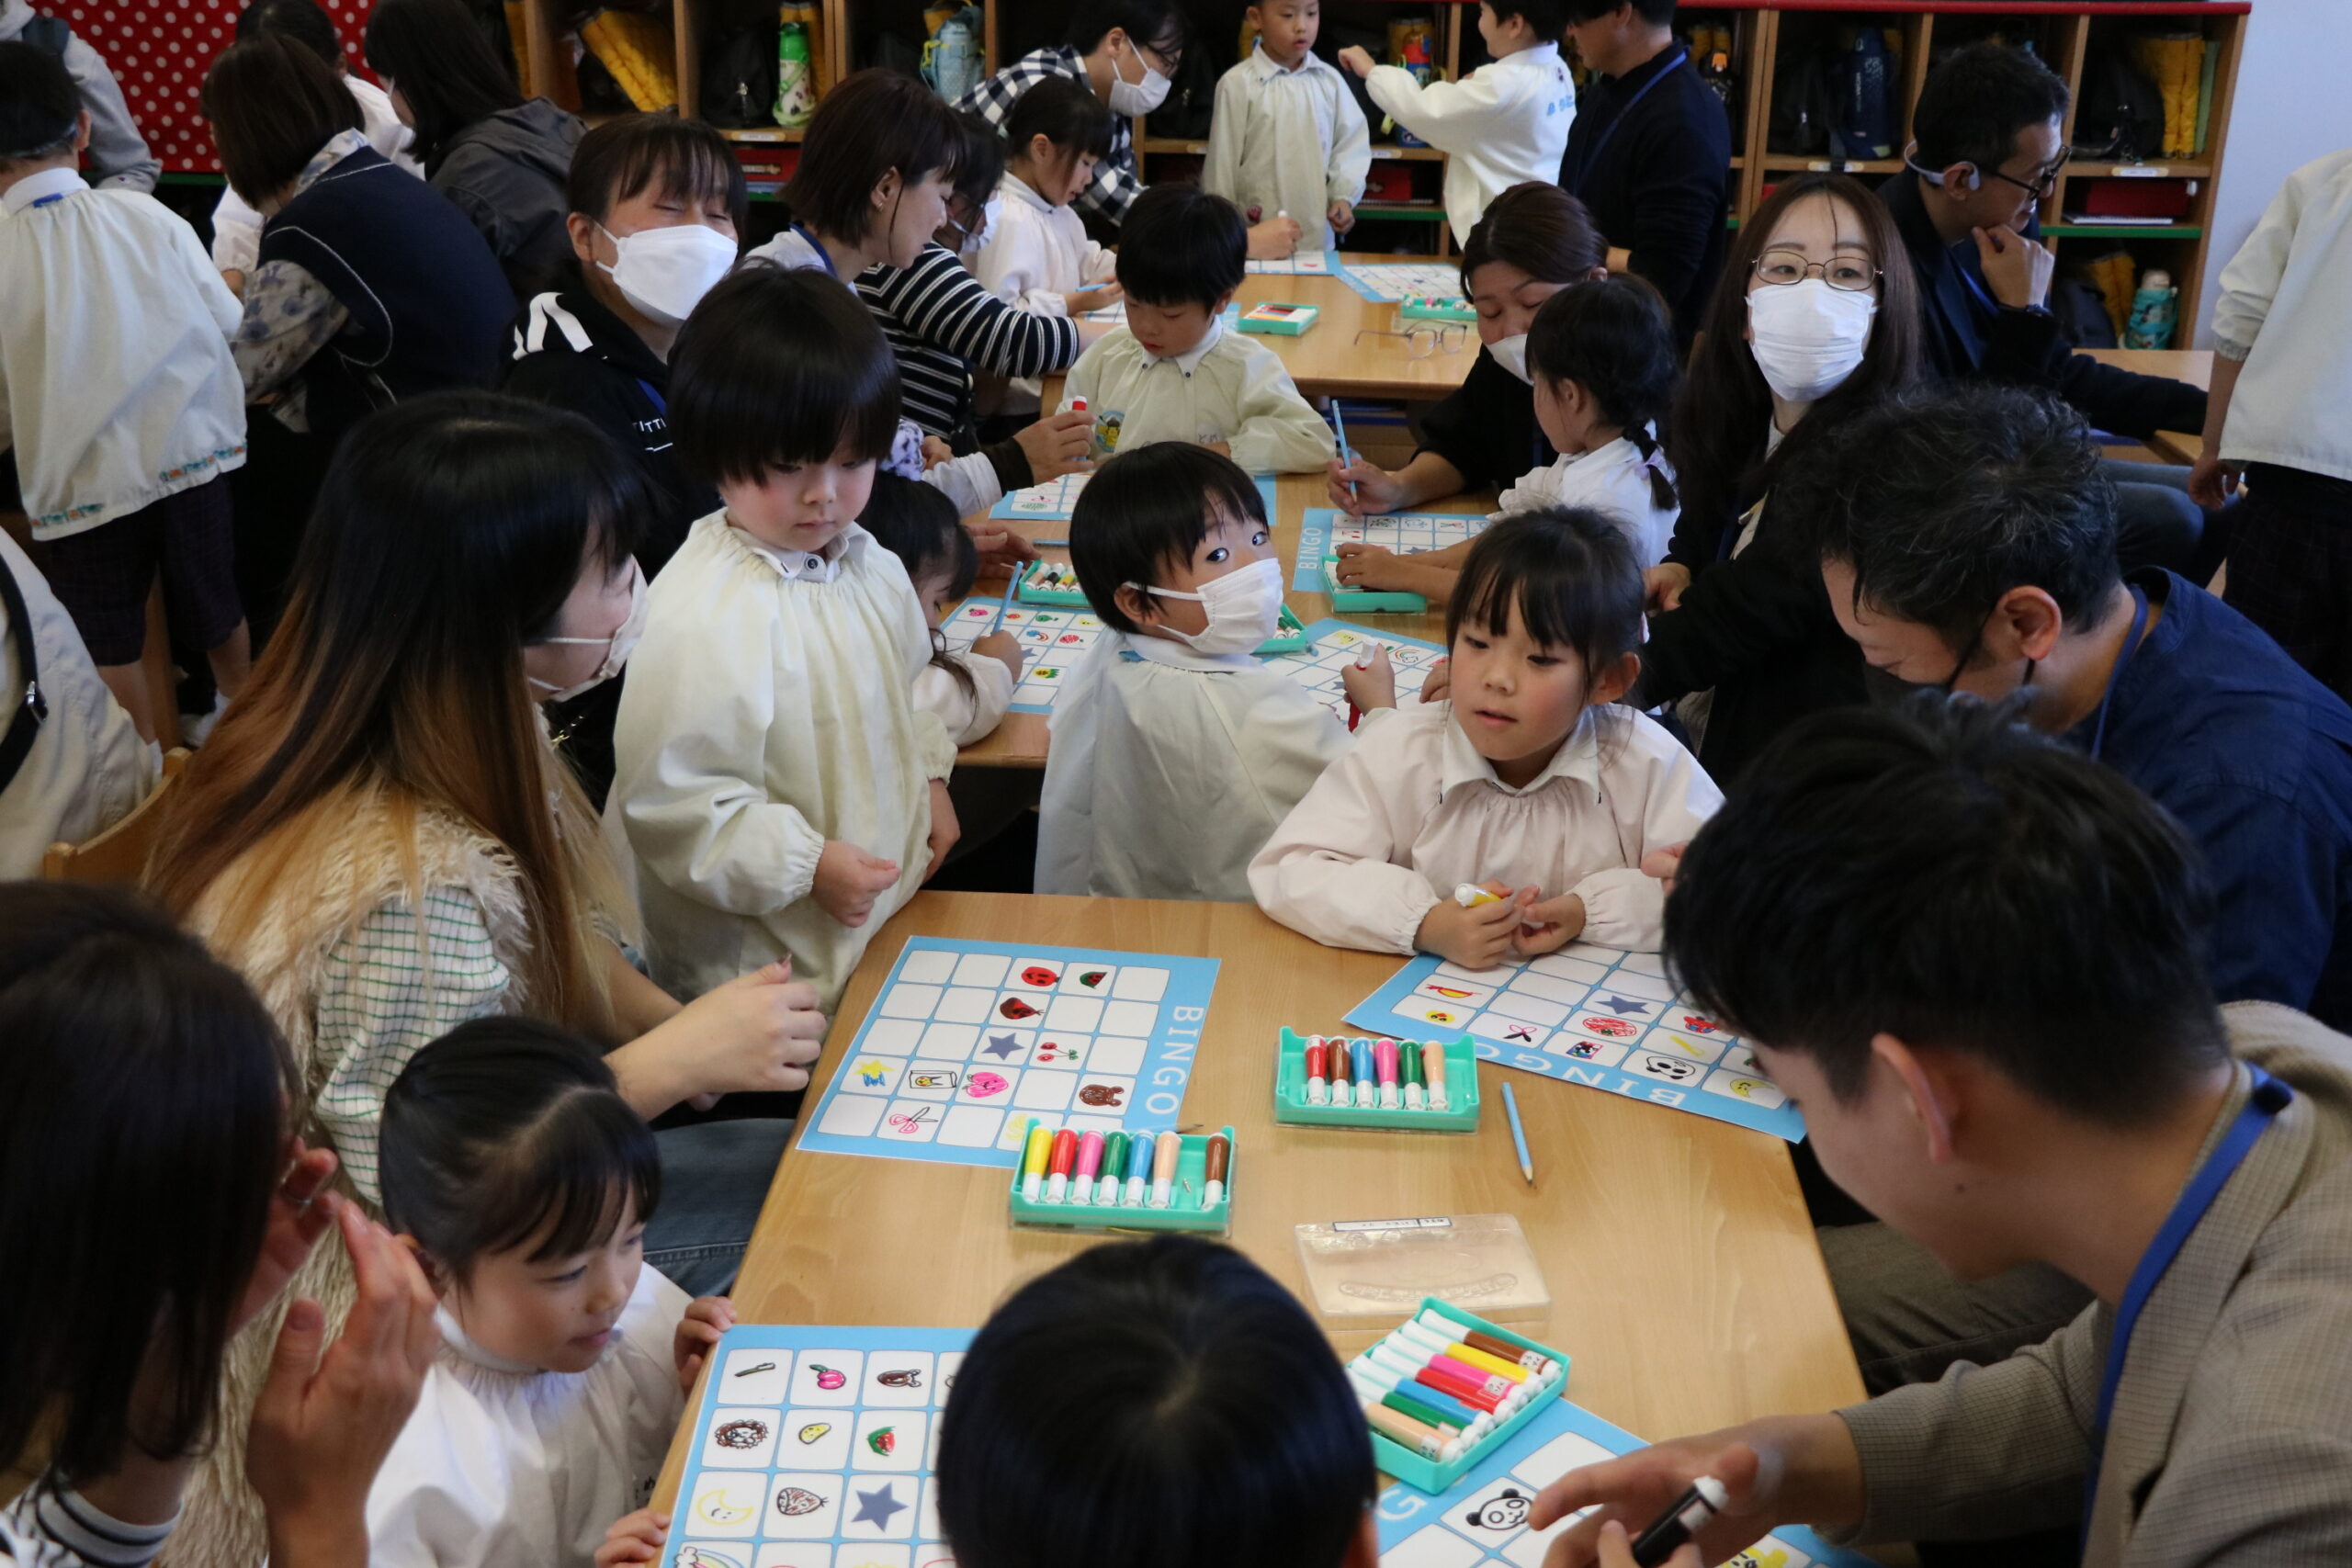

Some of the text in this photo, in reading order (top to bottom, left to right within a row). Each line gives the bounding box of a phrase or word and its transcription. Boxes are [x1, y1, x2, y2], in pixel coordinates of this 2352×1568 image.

[1298, 527, 1323, 570] BINGO
[1146, 1006, 1204, 1115] BINGO
[1475, 1042, 1687, 1107] BINGO
